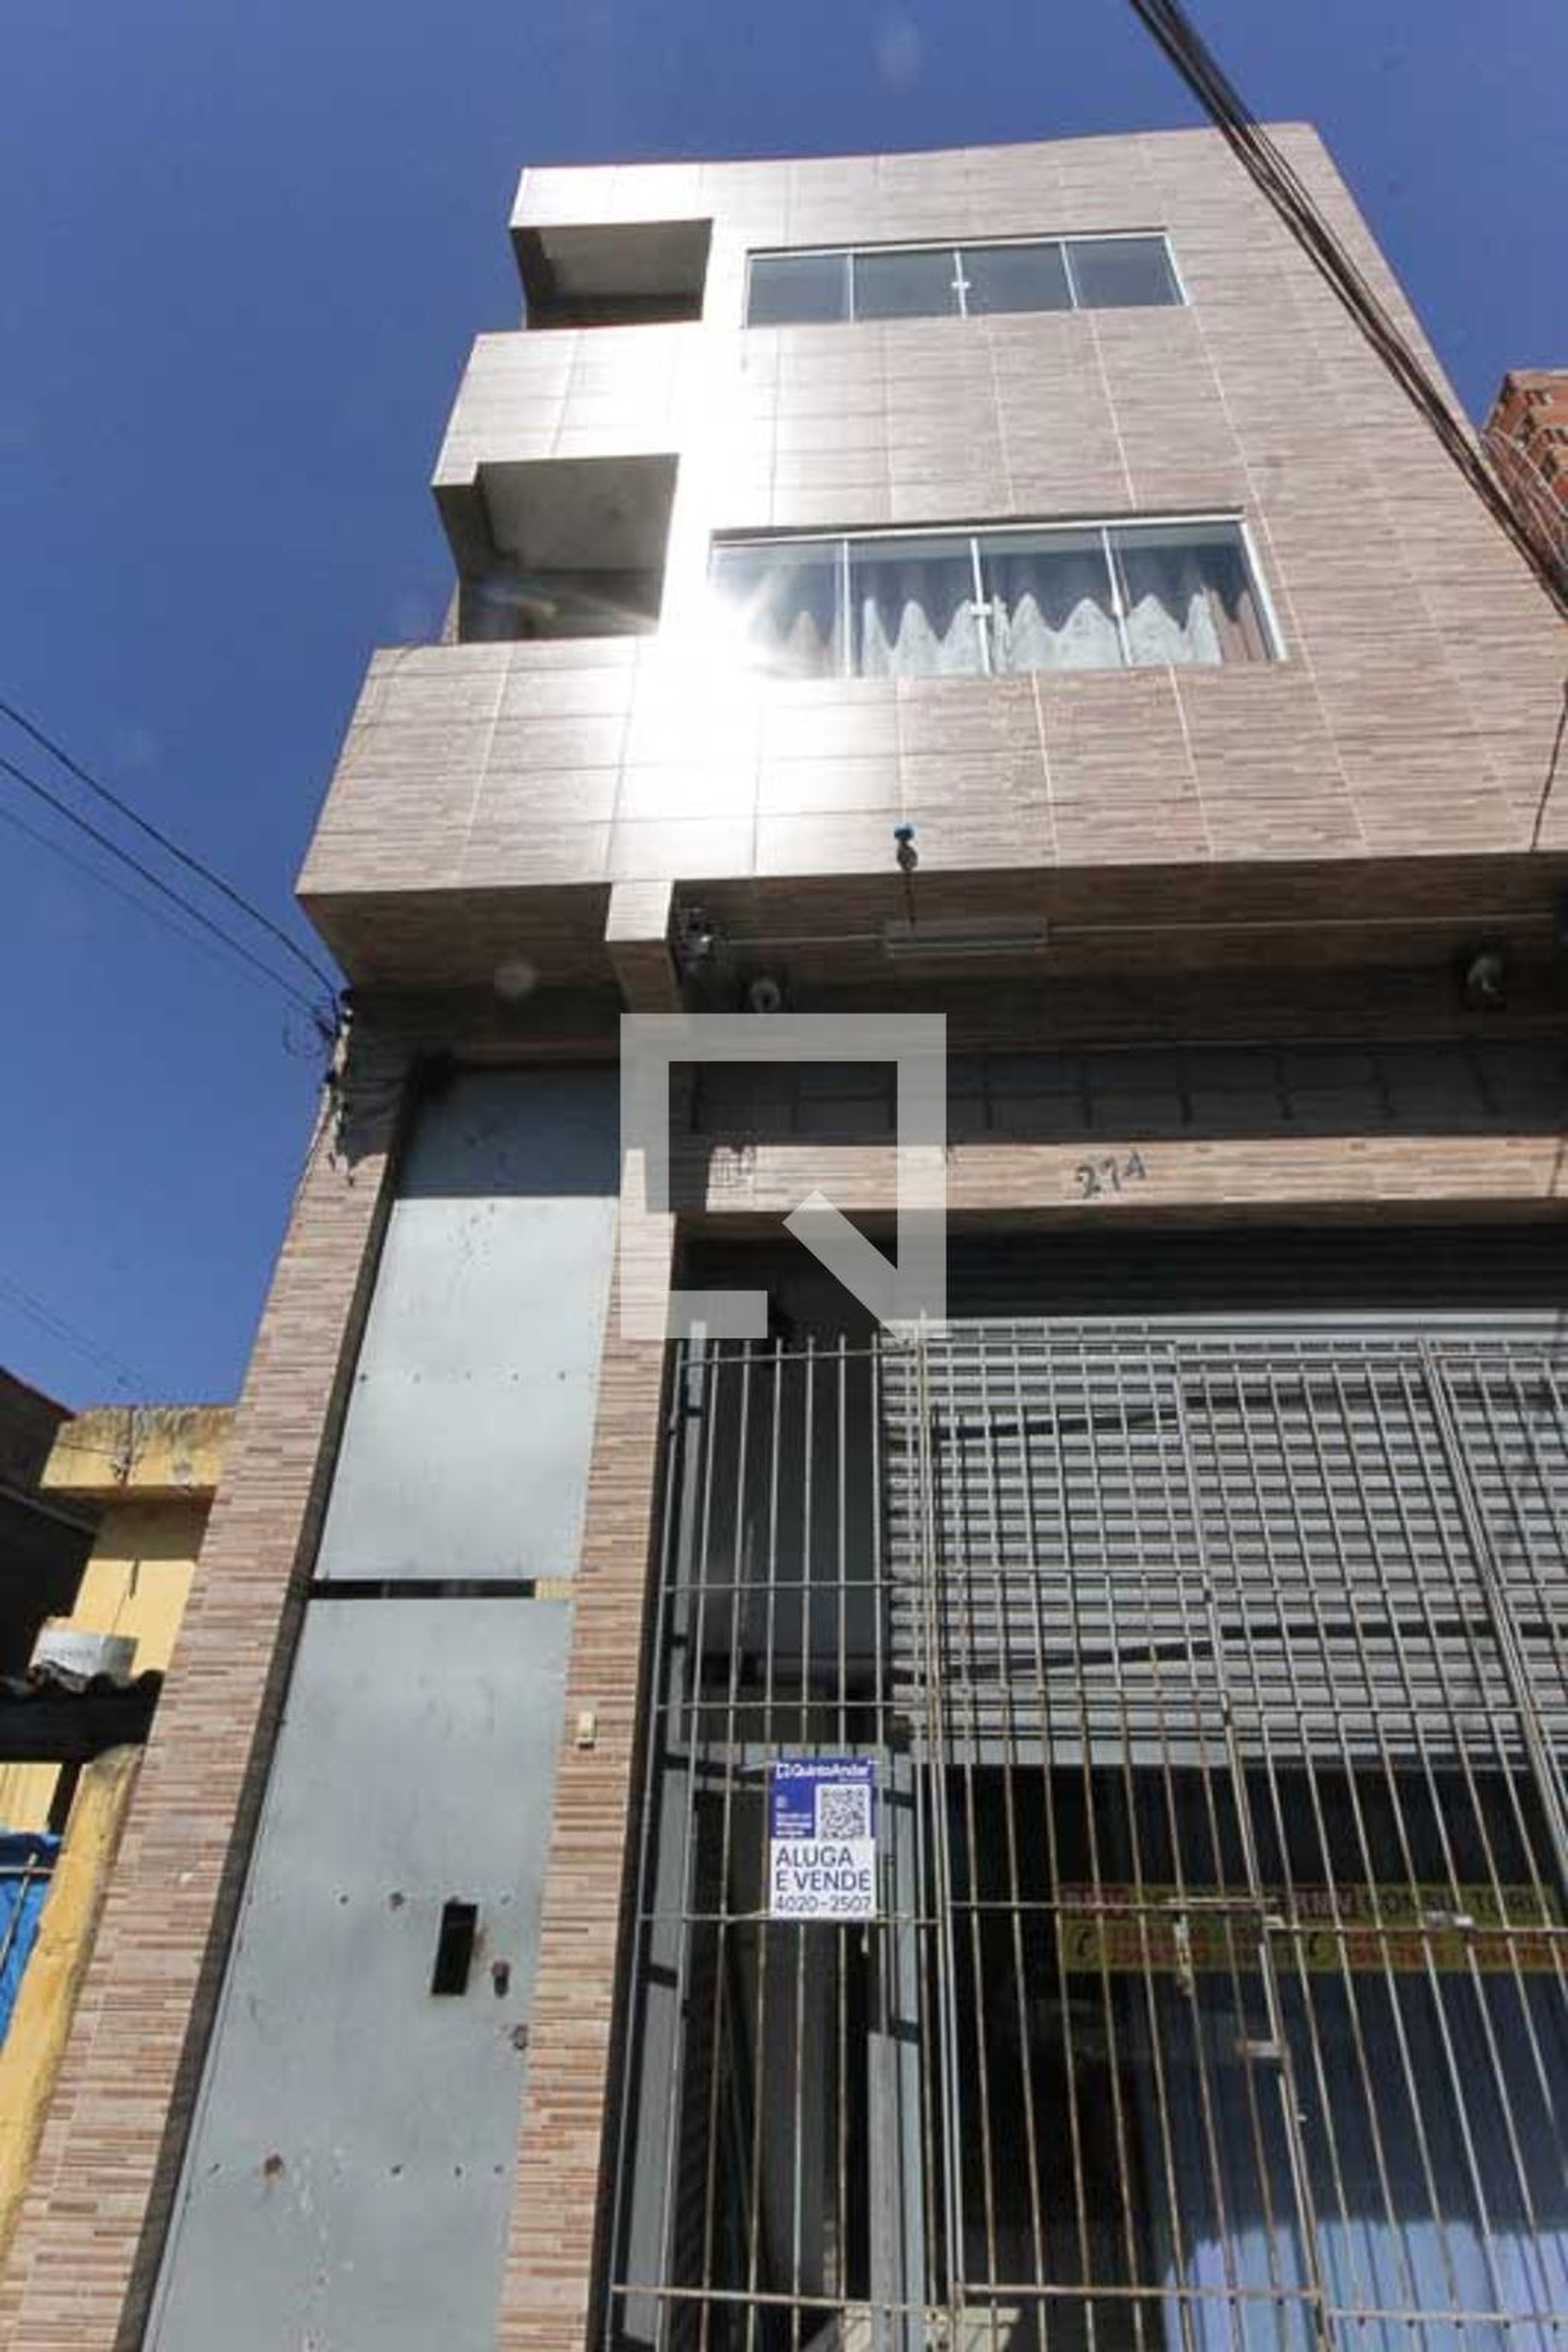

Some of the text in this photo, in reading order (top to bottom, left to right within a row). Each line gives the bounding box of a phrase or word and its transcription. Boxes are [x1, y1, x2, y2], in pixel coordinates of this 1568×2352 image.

[776, 1846, 854, 1867] ALUGA
[776, 1869, 871, 1891] E VENDE
[776, 1895, 871, 1912] 4020-2507
